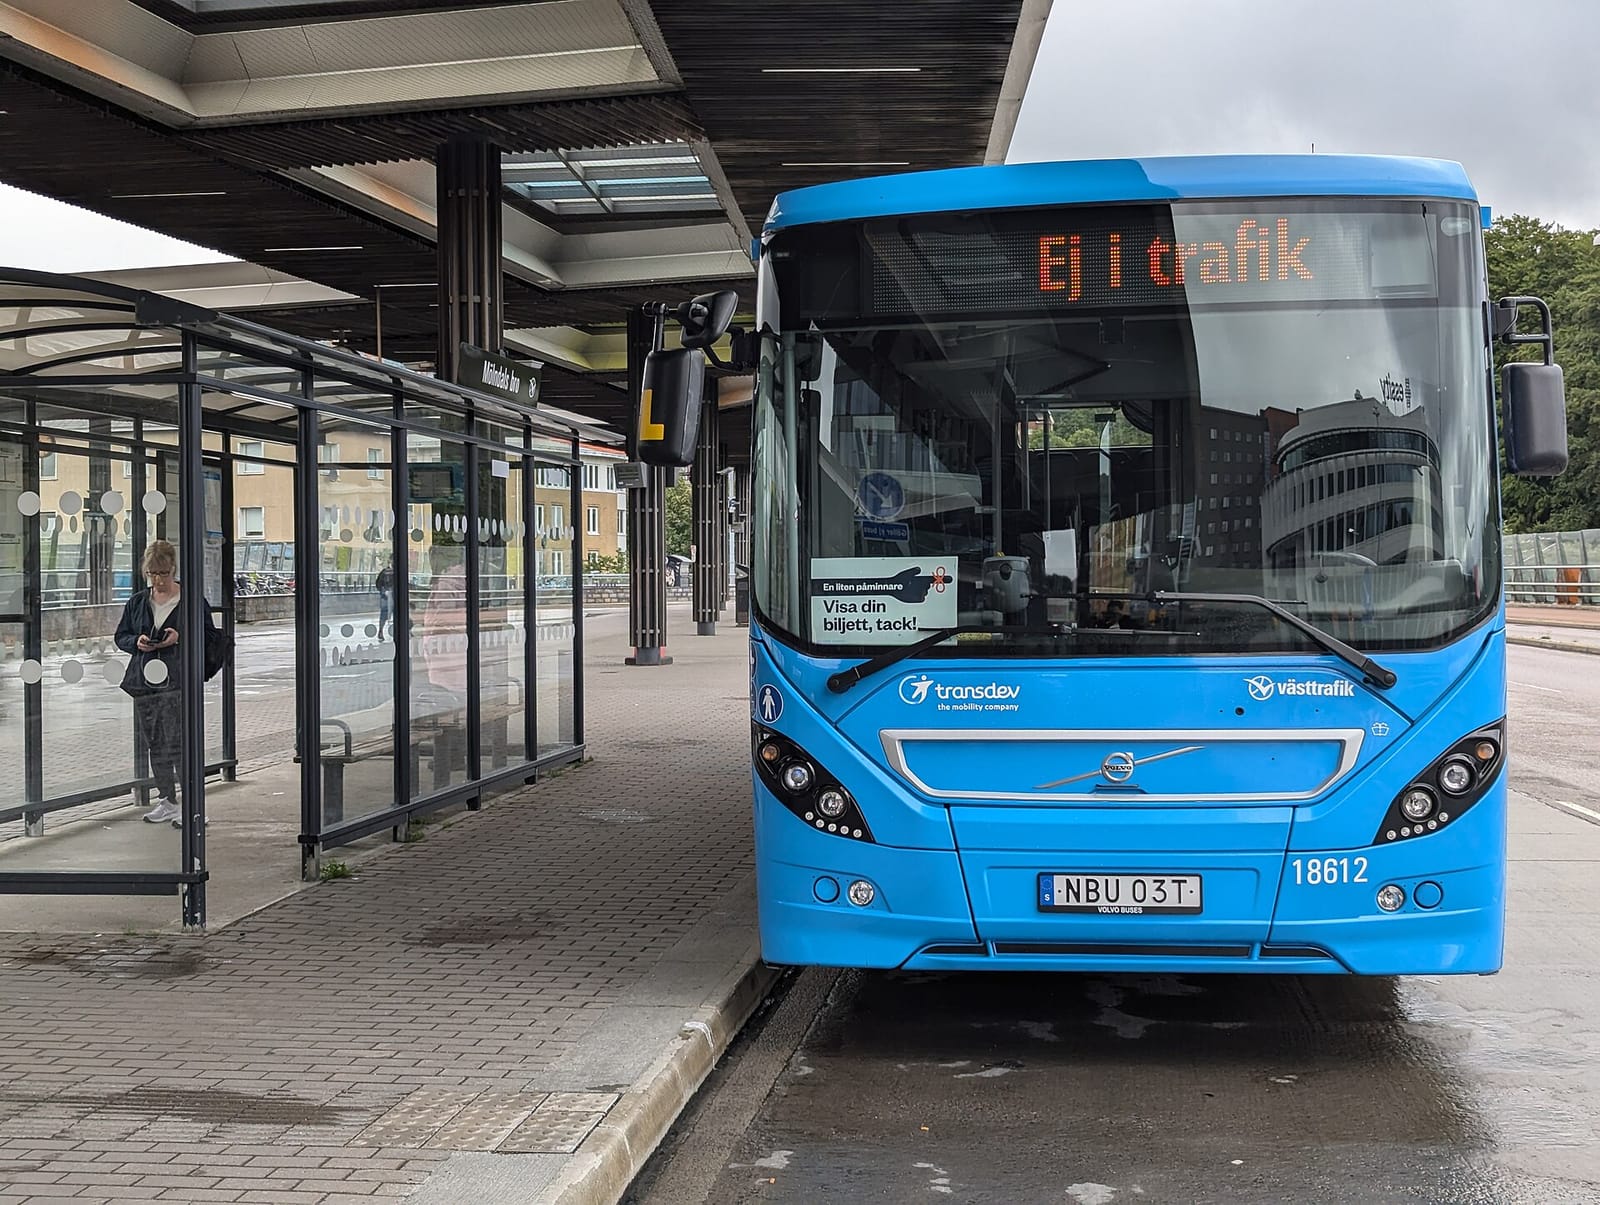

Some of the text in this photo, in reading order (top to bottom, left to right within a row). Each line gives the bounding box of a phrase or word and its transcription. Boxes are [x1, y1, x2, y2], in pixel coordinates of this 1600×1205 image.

[1039, 218, 1314, 301] Ej i trafik
[822, 582, 903, 594] En liten påminnare
[823, 599, 887, 613] Visa din
[823, 616, 917, 634] biljett, tack!
[934, 682, 1020, 699] transdev
[1277, 678, 1356, 697] västtrafik
[937, 702, 1019, 712] the mobility company
[1292, 856, 1369, 885] 18612
[1044, 893, 1051, 902] S
[1064, 878, 1120, 904] NBU
[1097, 906, 1144, 914] VOLVO BUSES
